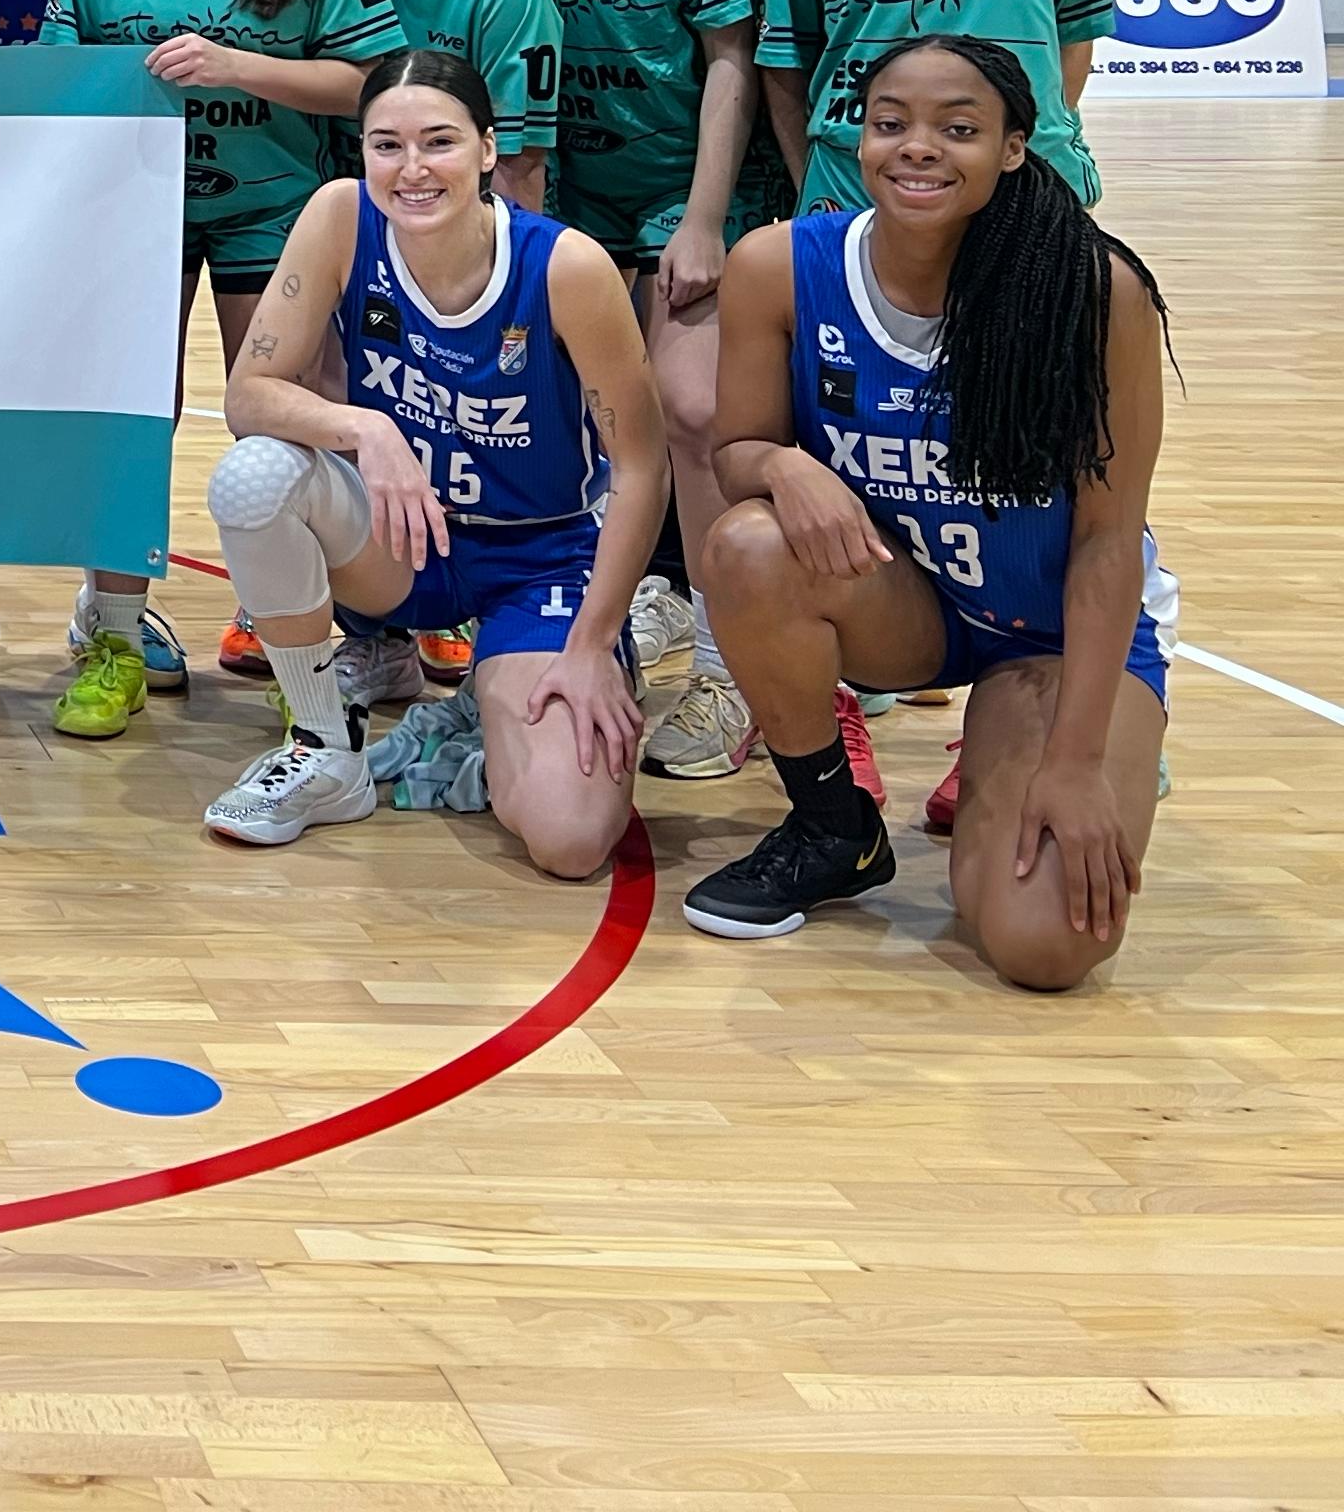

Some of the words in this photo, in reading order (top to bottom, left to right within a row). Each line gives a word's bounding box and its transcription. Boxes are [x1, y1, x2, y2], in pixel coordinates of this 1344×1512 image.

[427, 29, 465, 50] vive
[520, 44, 556, 101] 10
[563, 63, 649, 91] PONA
[1139, 61, 1167, 74] 394
[1245, 61, 1272, 74] 793
[185, 98, 272, 127] PONA
[395, 402, 436, 430] CLUB
[823, 424, 952, 487] XER
[865, 483, 917, 502] CLUB
[897, 513, 984, 588] 13
